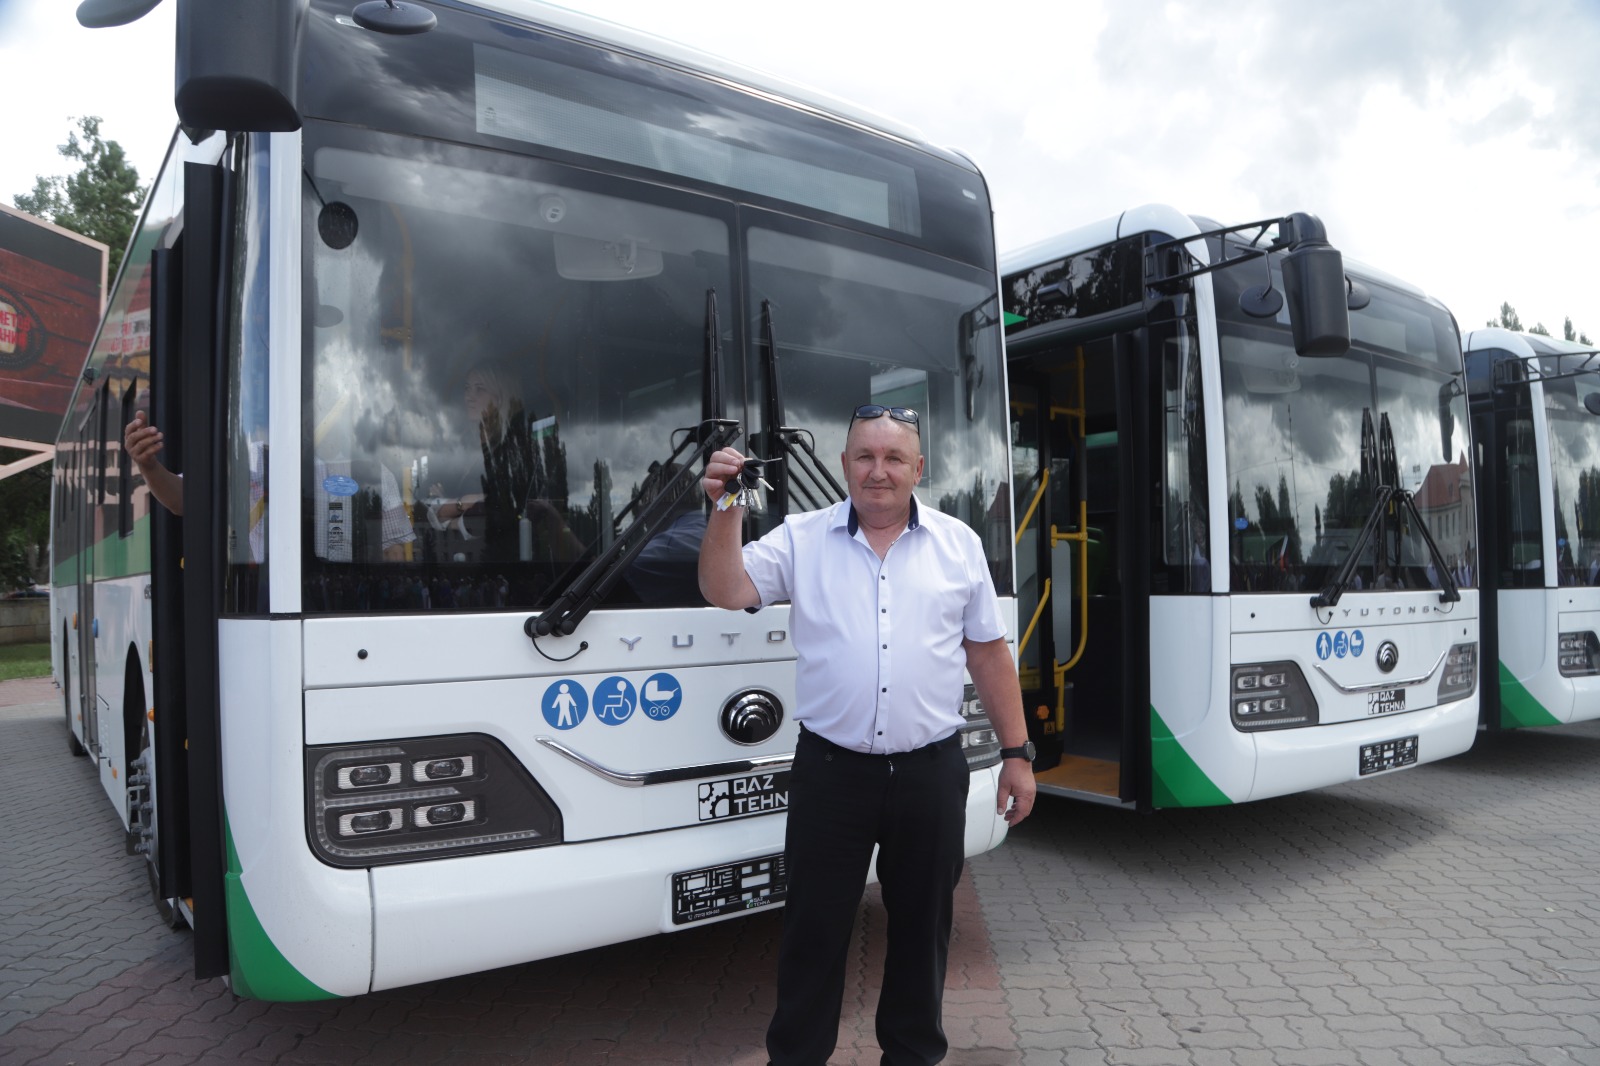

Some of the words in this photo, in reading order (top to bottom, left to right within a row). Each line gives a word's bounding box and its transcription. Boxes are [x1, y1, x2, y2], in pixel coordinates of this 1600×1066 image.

[1342, 606, 1430, 617] YUTONG
[1380, 690, 1396, 702] QAZ
[1380, 700, 1406, 713] TEHNA
[733, 774, 774, 795] QAZ
